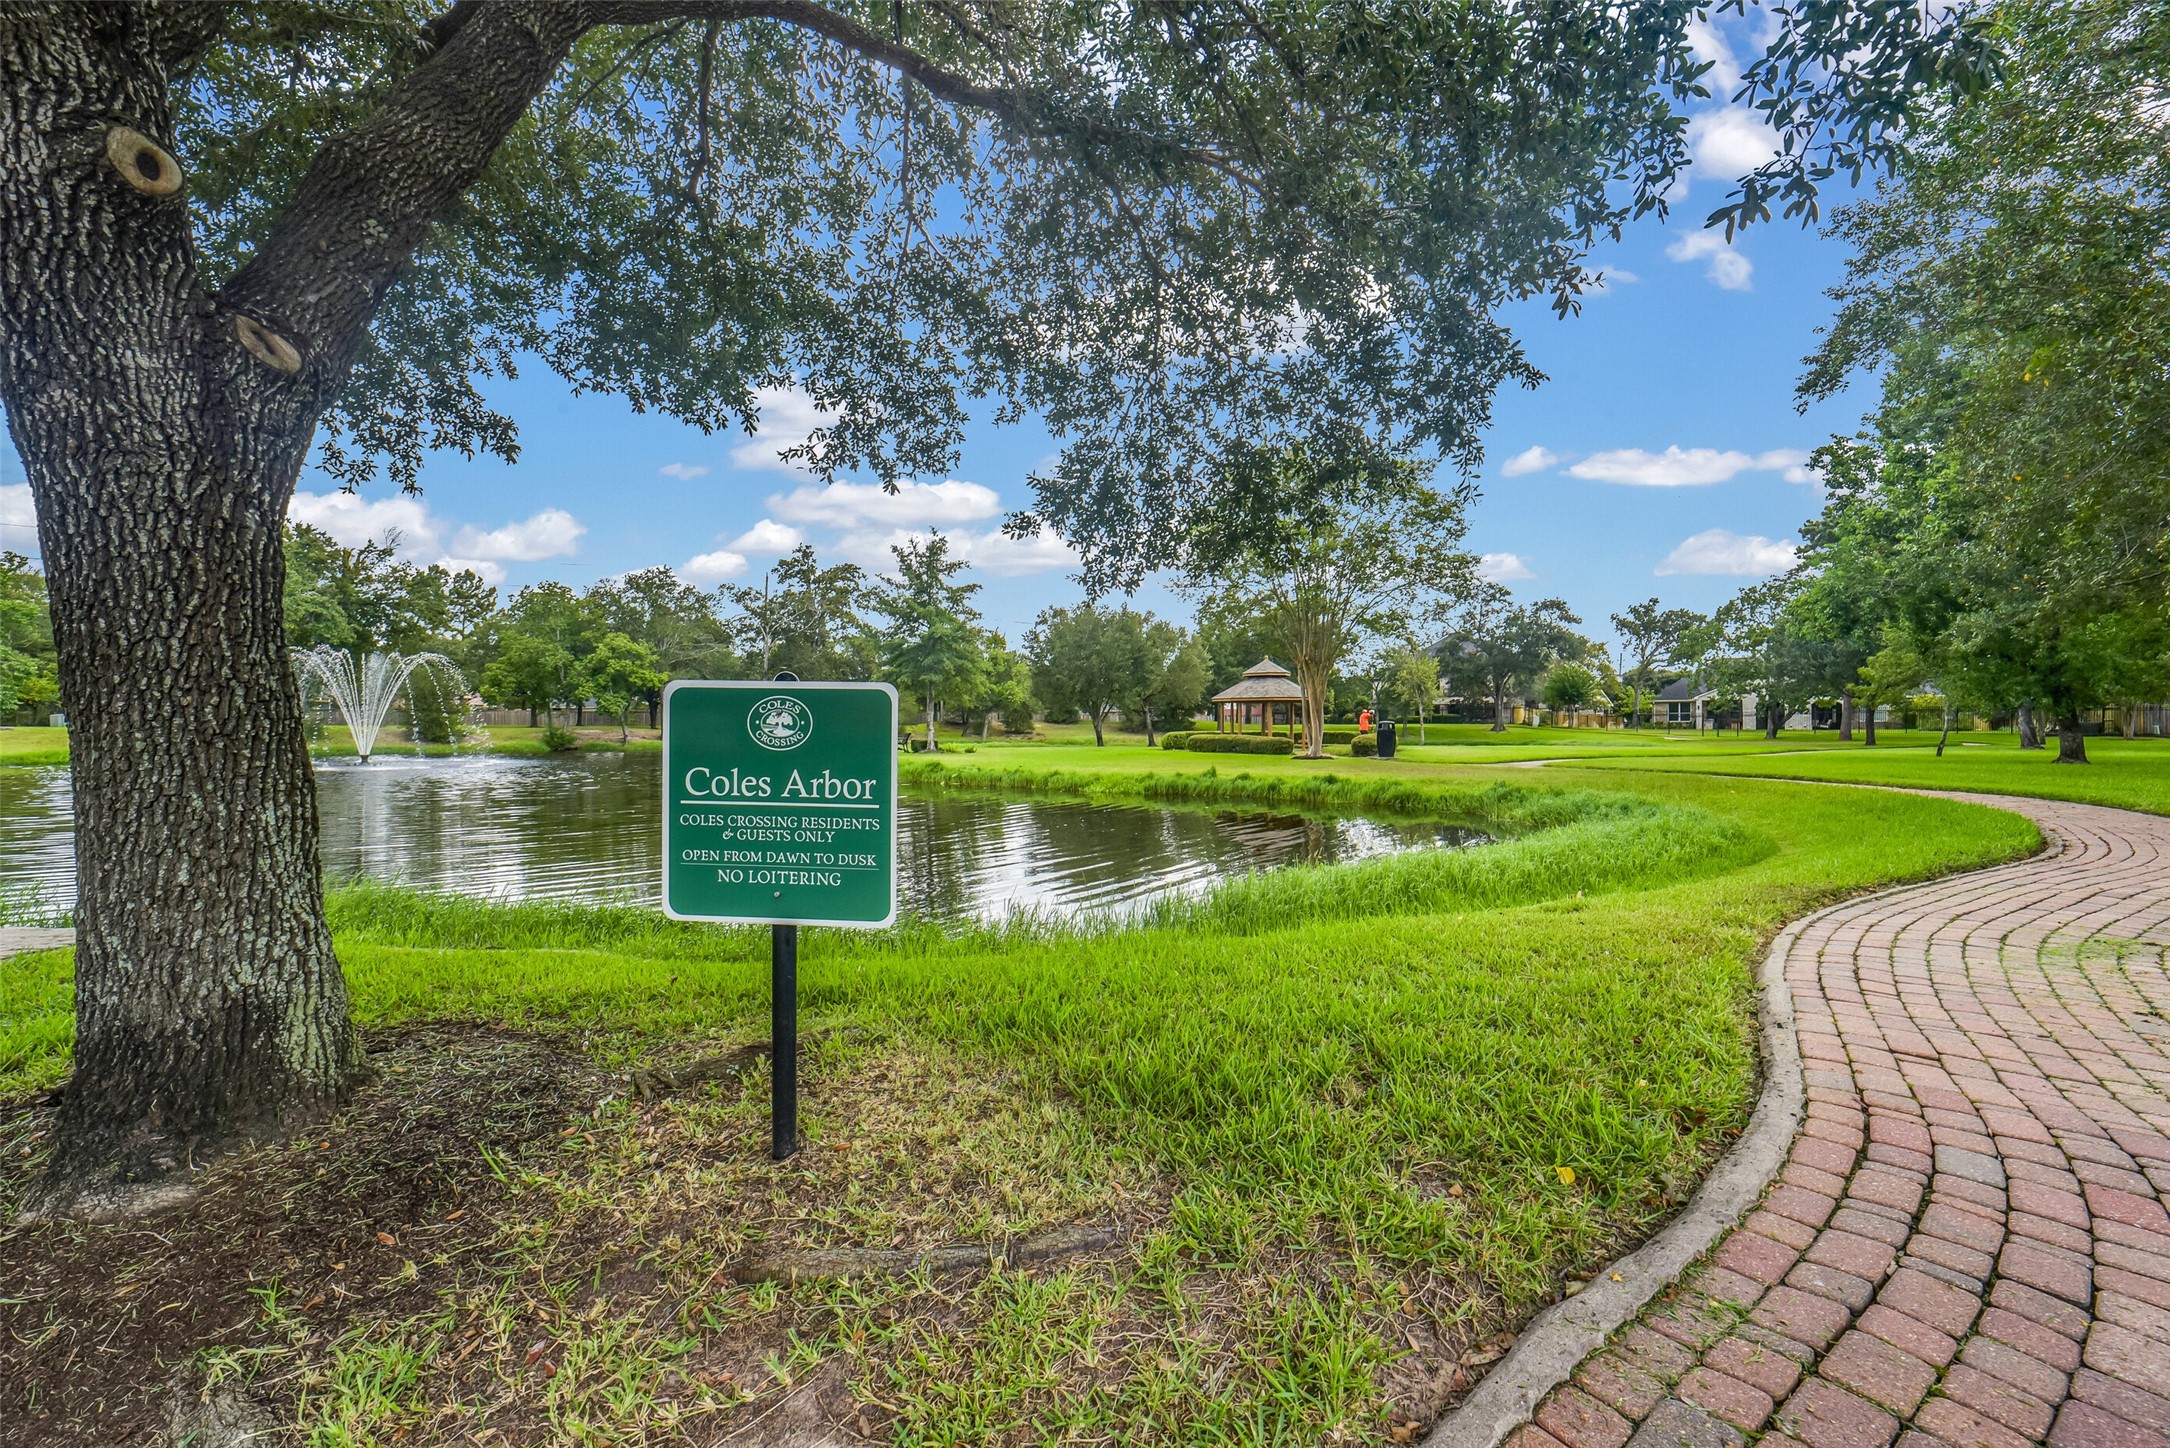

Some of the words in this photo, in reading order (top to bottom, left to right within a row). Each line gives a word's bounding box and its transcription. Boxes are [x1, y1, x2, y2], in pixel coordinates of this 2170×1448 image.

[759, 700, 802, 714] COLES
[756, 730, 804, 746] CROSSING
[685, 767, 771, 797] Coles
[781, 768, 876, 799] Arbor
[680, 814, 724, 826] COLES
[727, 815, 798, 828] CROSSING
[801, 817, 880, 830] RESIDENTS
[722, 828, 734, 840] &
[737, 829, 791, 842] GUESTS
[794, 830, 835, 843] ONLY
[682, 849, 720, 861] OPEN
[723, 851, 762, 863] FROM
[766, 852, 811, 864] DAWN
[814, 853, 834, 865] TO
[838, 854, 876, 866] DUSK
[717, 869, 743, 883] NO
[748, 870, 842, 886] LOITERING
